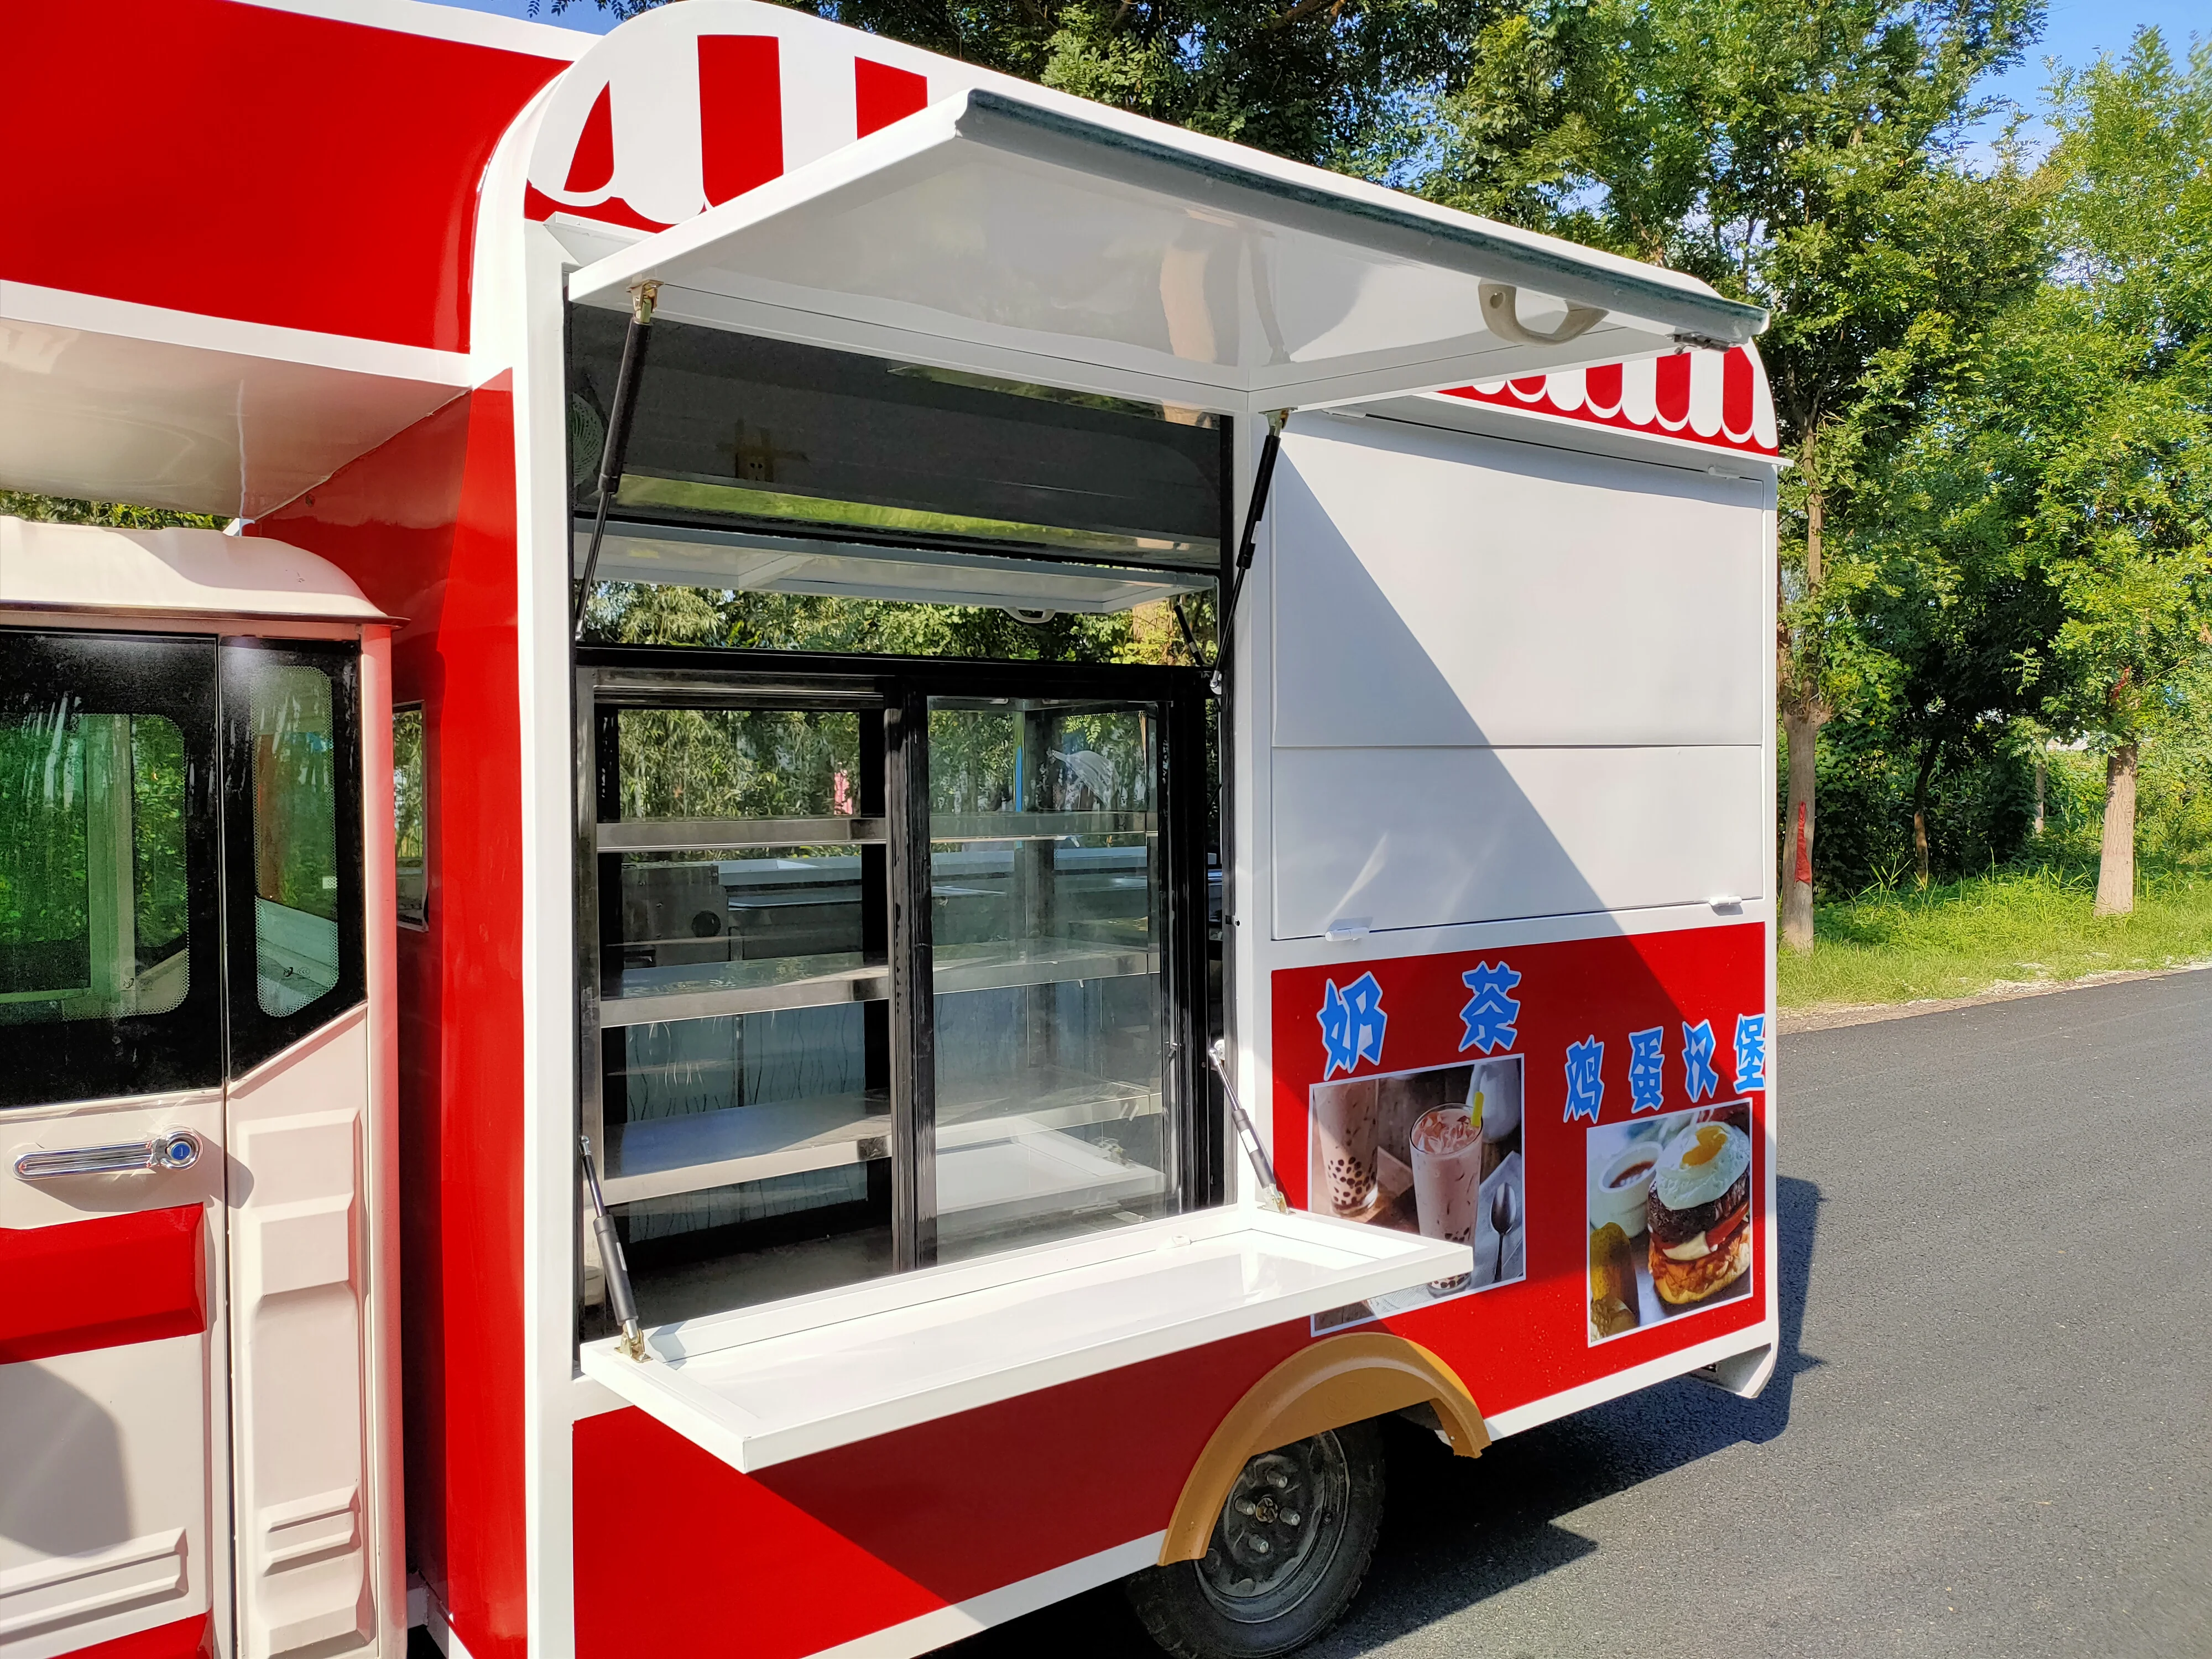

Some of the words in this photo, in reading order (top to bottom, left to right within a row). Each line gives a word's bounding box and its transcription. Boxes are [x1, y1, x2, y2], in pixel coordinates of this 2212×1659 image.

[1317, 961, 1522, 1081] 奶茶
[1563, 1013, 1766, 1124] 鸡蛋汉堡
